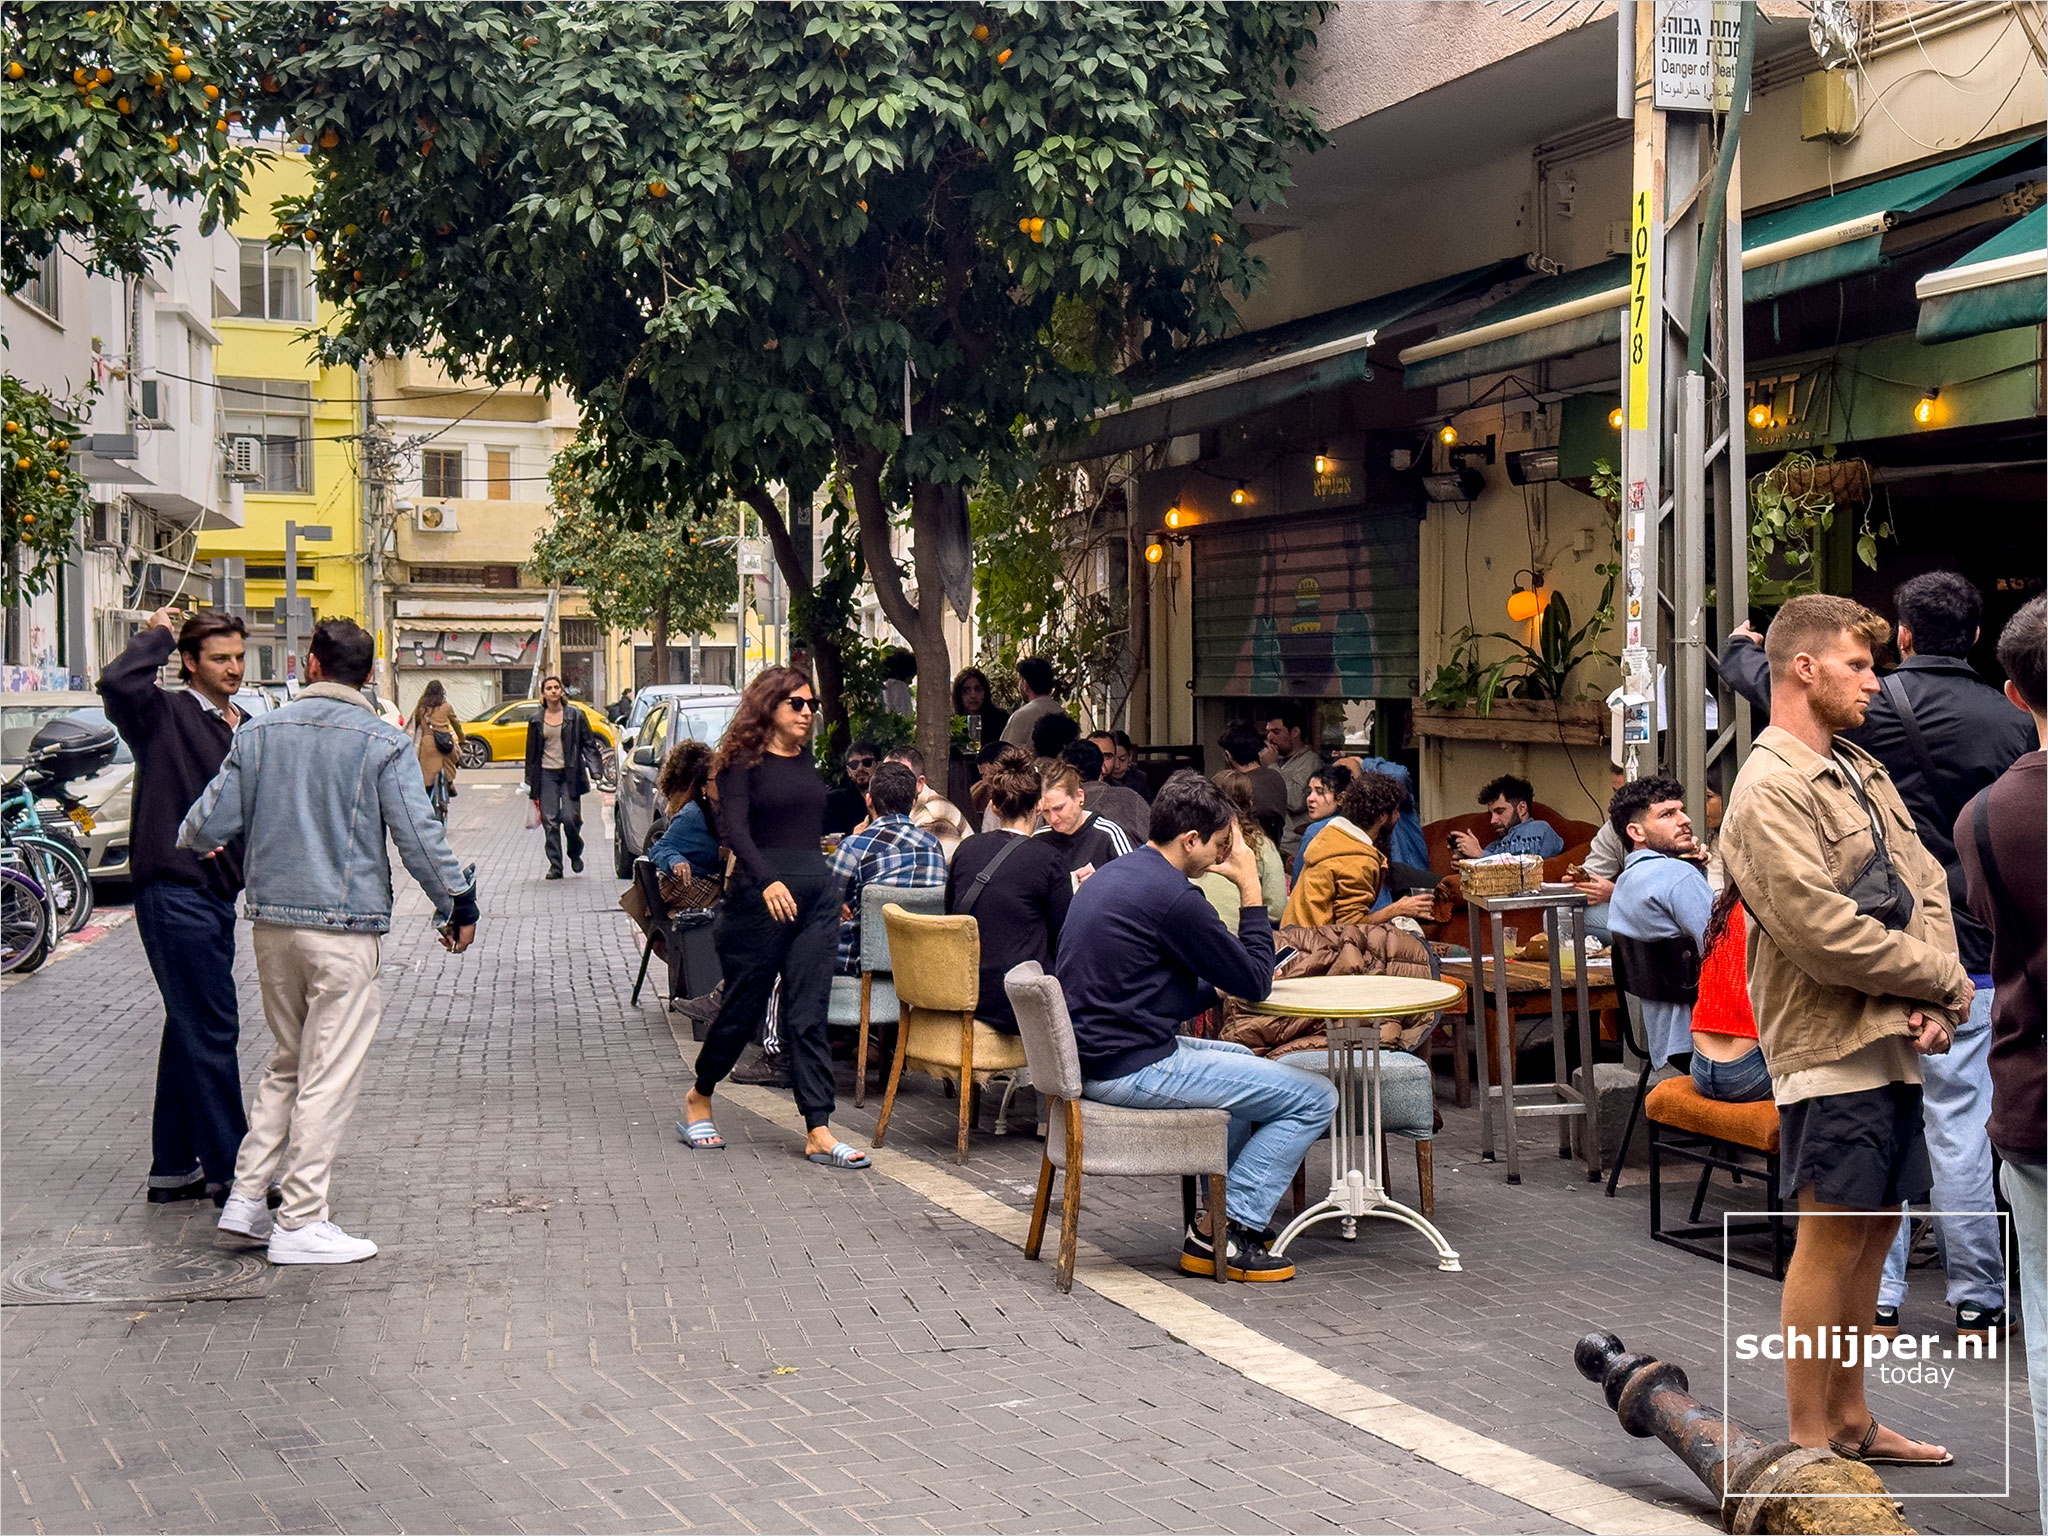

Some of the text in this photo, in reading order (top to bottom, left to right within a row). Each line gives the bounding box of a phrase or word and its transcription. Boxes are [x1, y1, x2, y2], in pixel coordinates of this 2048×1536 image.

[1663, 16, 1702, 36] גבוה!
[1662, 36, 1698, 55] מוות!
[1662, 58, 1737, 79] Danger of Deat
[1632, 192, 1648, 365] 10778
